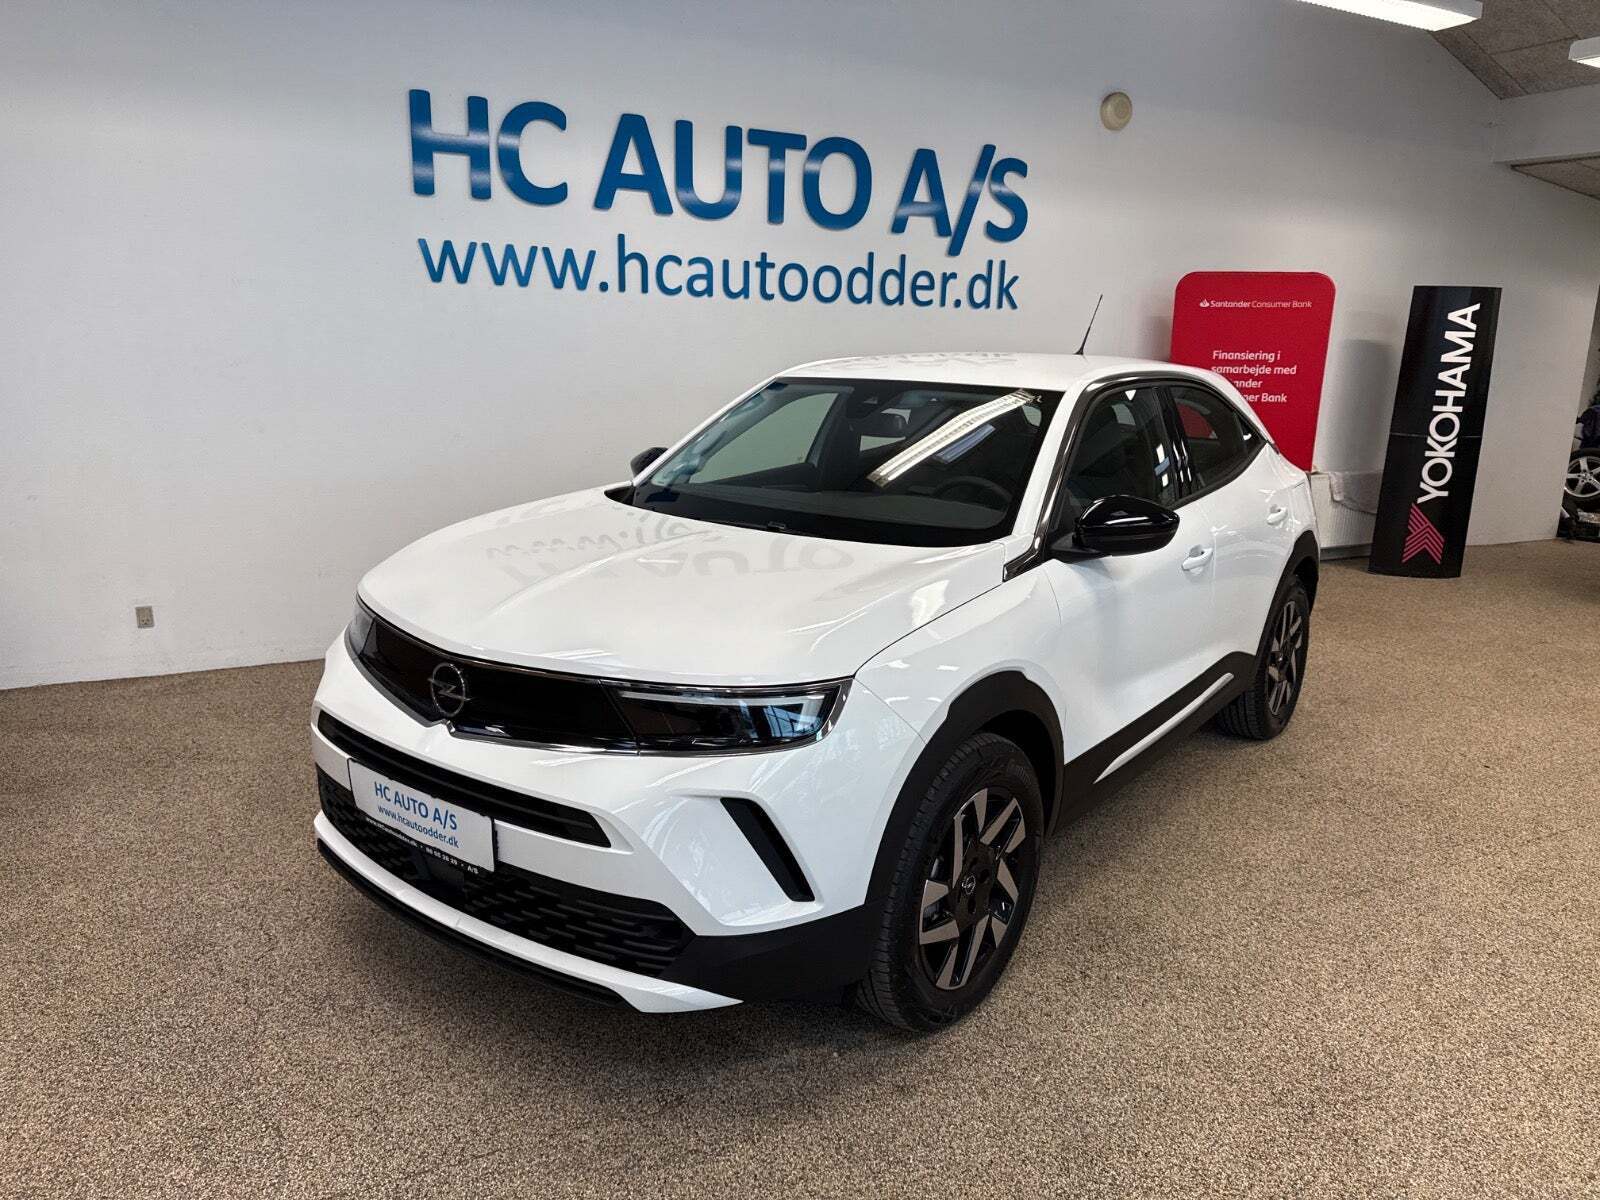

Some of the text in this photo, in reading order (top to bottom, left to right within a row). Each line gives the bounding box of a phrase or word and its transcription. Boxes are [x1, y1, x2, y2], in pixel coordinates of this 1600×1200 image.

[408, 88, 1029, 258] HC AUTO A/S
[417, 232, 1019, 310] www.hcautoodder.dk
[1210, 300, 1312, 308] Santander Consumer Bank
[1211, 365, 1297, 376] samarbejde med
[1212, 350, 1281, 363] Finansiering i
[1260, 393, 1288, 403] Bank
[1416, 302, 1481, 504] YOKOHAMA
[374, 781, 458, 831] HC AUTO A/S
